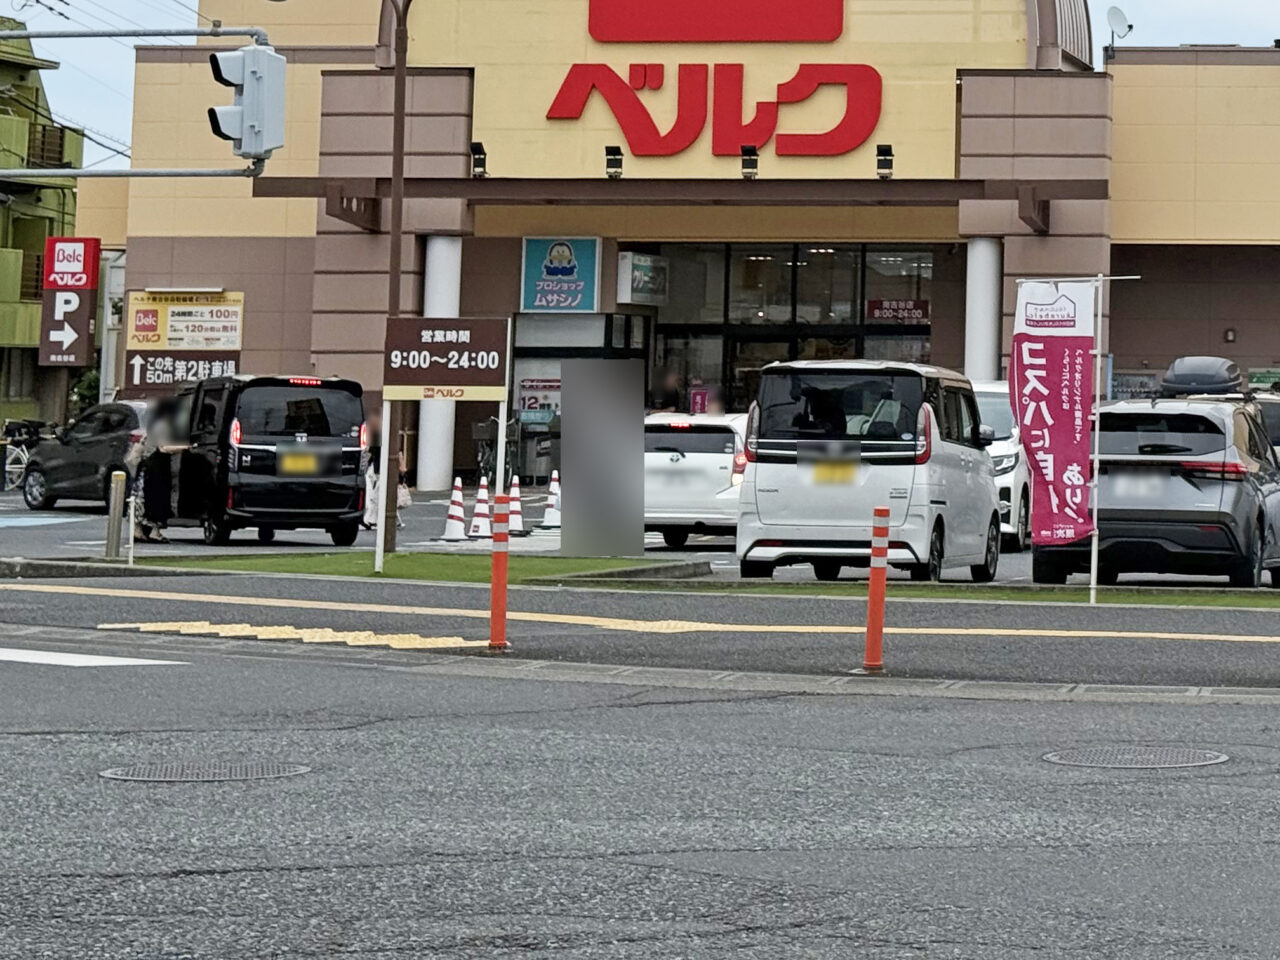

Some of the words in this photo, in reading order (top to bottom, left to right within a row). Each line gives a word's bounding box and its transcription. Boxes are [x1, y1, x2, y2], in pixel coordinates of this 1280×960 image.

[546, 62, 883, 157] ベルク
[56, 248, 82, 263] Belc
[48, 273, 87, 286] ベルク
[535, 281, 585, 290] プロショップ
[54, 291, 80, 320] P
[533, 292, 582, 307] ムサシノ
[136, 312, 157, 326] Belc
[132, 333, 161, 343] ベルク
[421, 329, 470, 343] 営業時間
[146, 356, 174, 371] この先
[174, 360, 236, 381] 第2駐車場
[146, 371, 173, 384] 50m
[436, 388, 465, 398] ベルク
